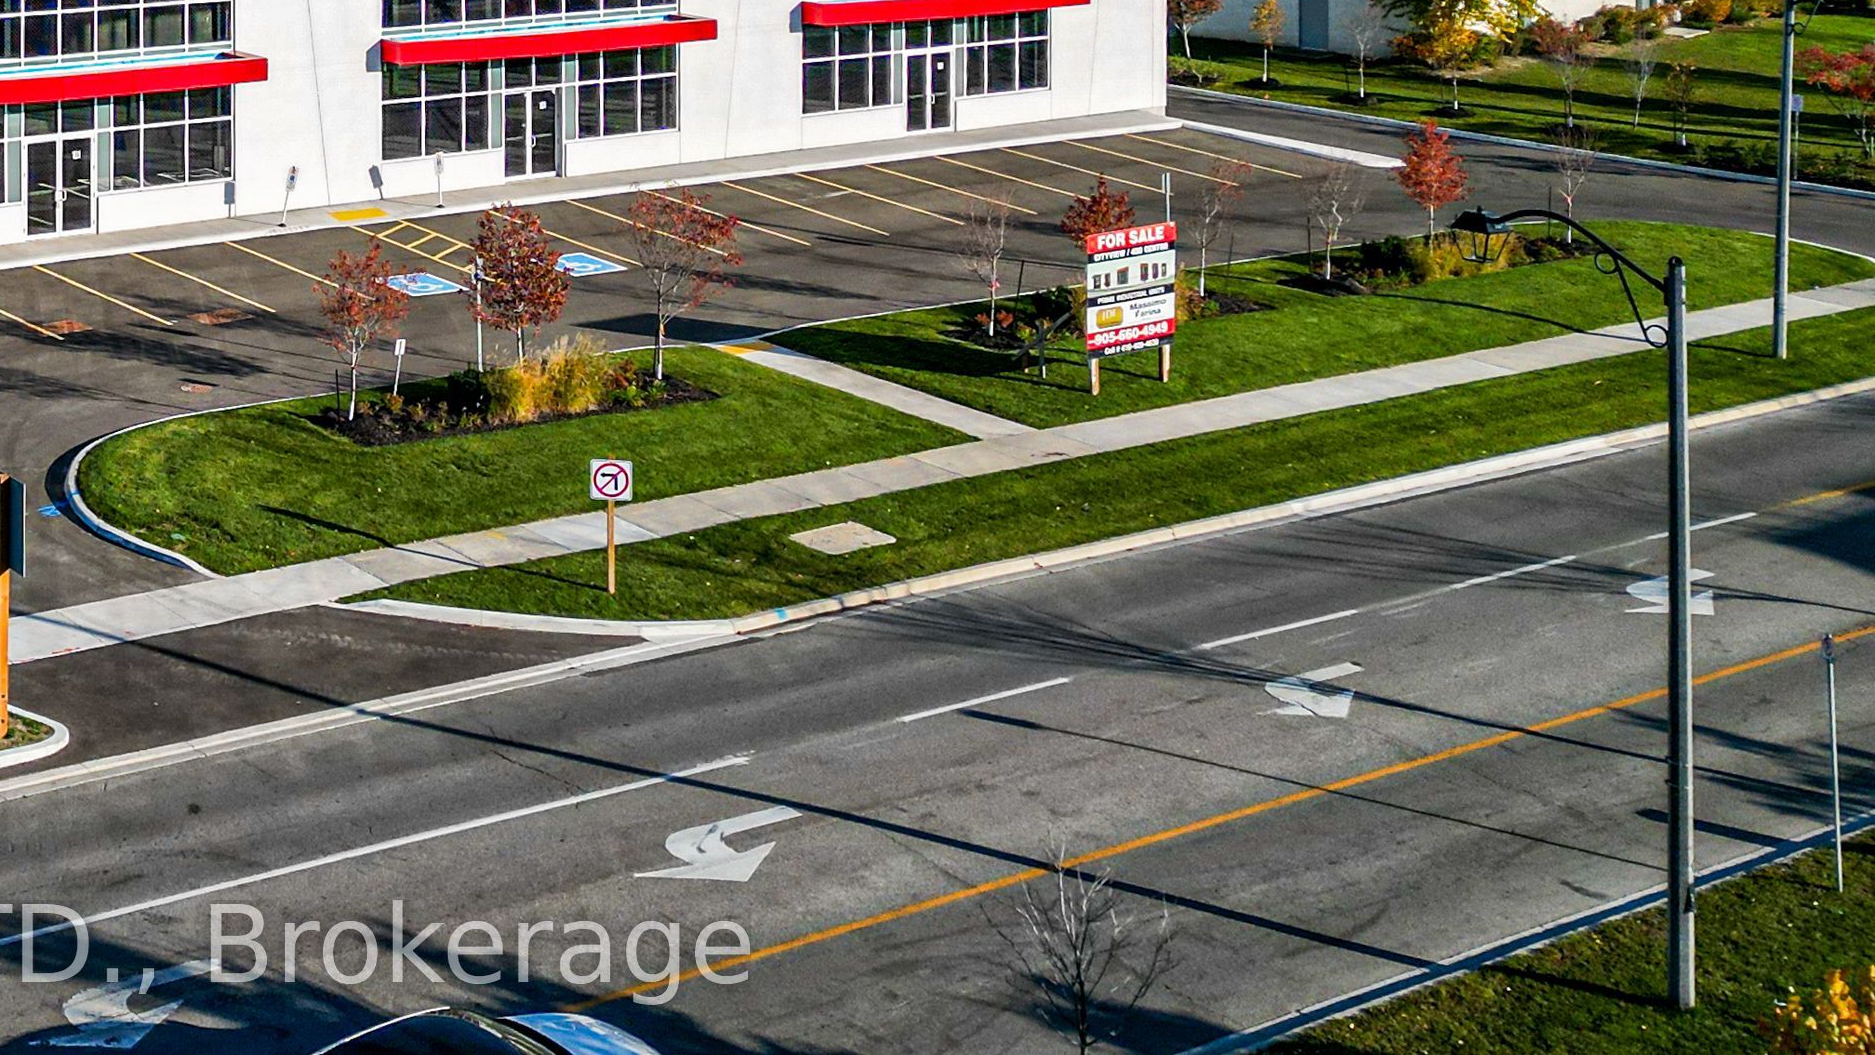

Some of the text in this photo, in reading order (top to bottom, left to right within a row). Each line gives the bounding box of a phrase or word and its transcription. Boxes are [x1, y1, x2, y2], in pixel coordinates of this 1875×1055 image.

[1097, 226, 1164, 250] FOR SALE
[1129, 299, 1167, 310] Massimo
[1135, 308, 1161, 318] Farina
